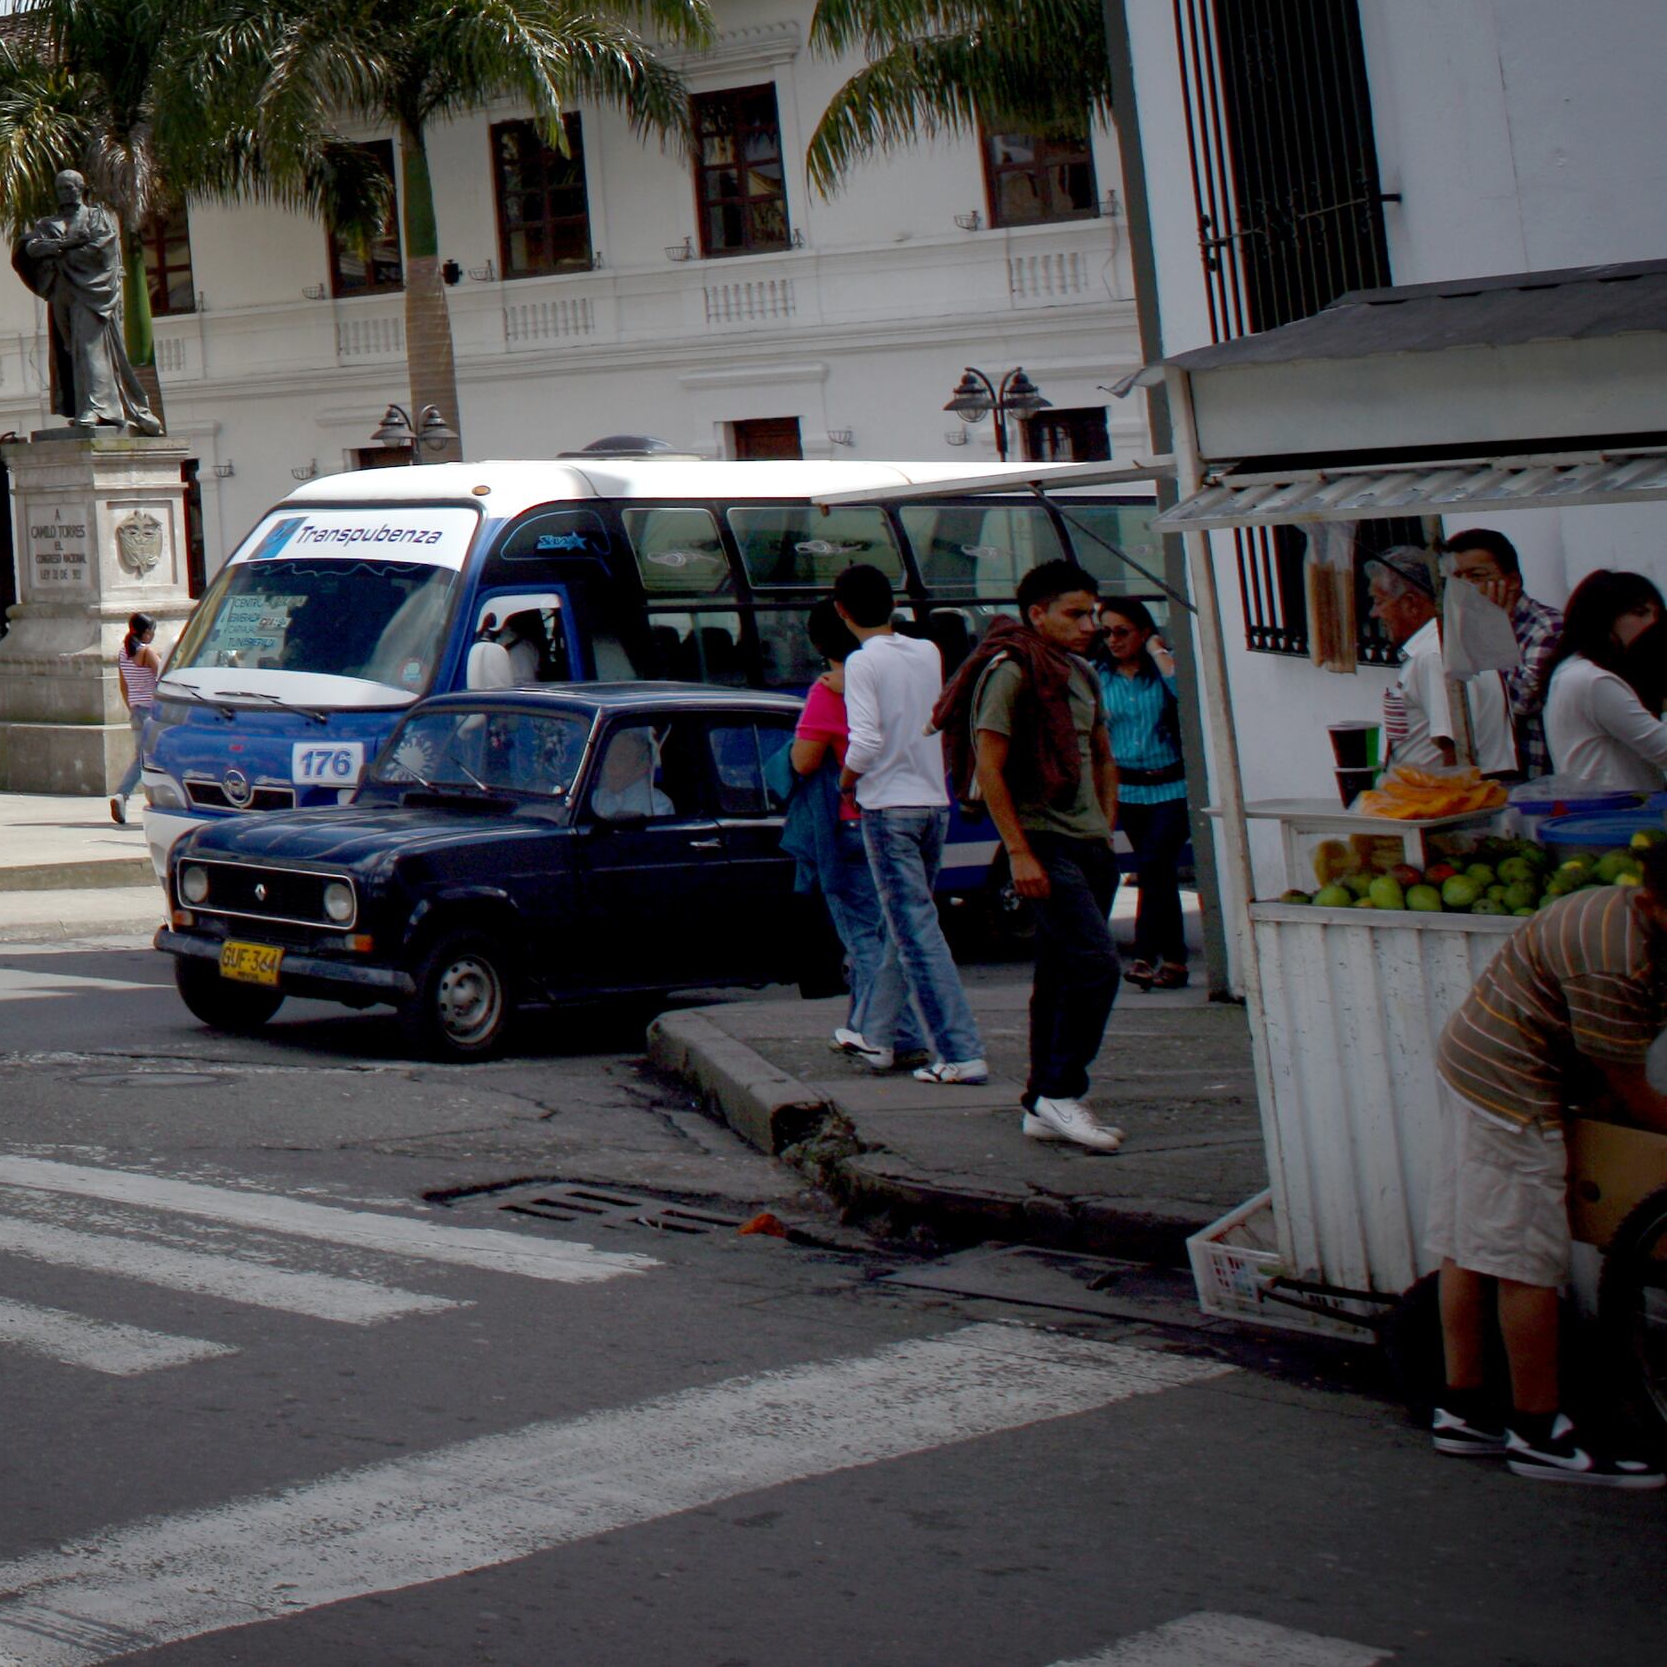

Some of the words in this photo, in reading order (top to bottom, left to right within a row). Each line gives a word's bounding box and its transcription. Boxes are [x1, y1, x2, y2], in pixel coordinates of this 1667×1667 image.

[55, 508, 60, 521] A
[31, 525, 56, 539] CAMILO
[58, 525, 85, 539] TORRES
[296, 523, 443, 547] Transpubenza
[54, 541, 63, 550] EL
[300, 749, 353, 777] 176
